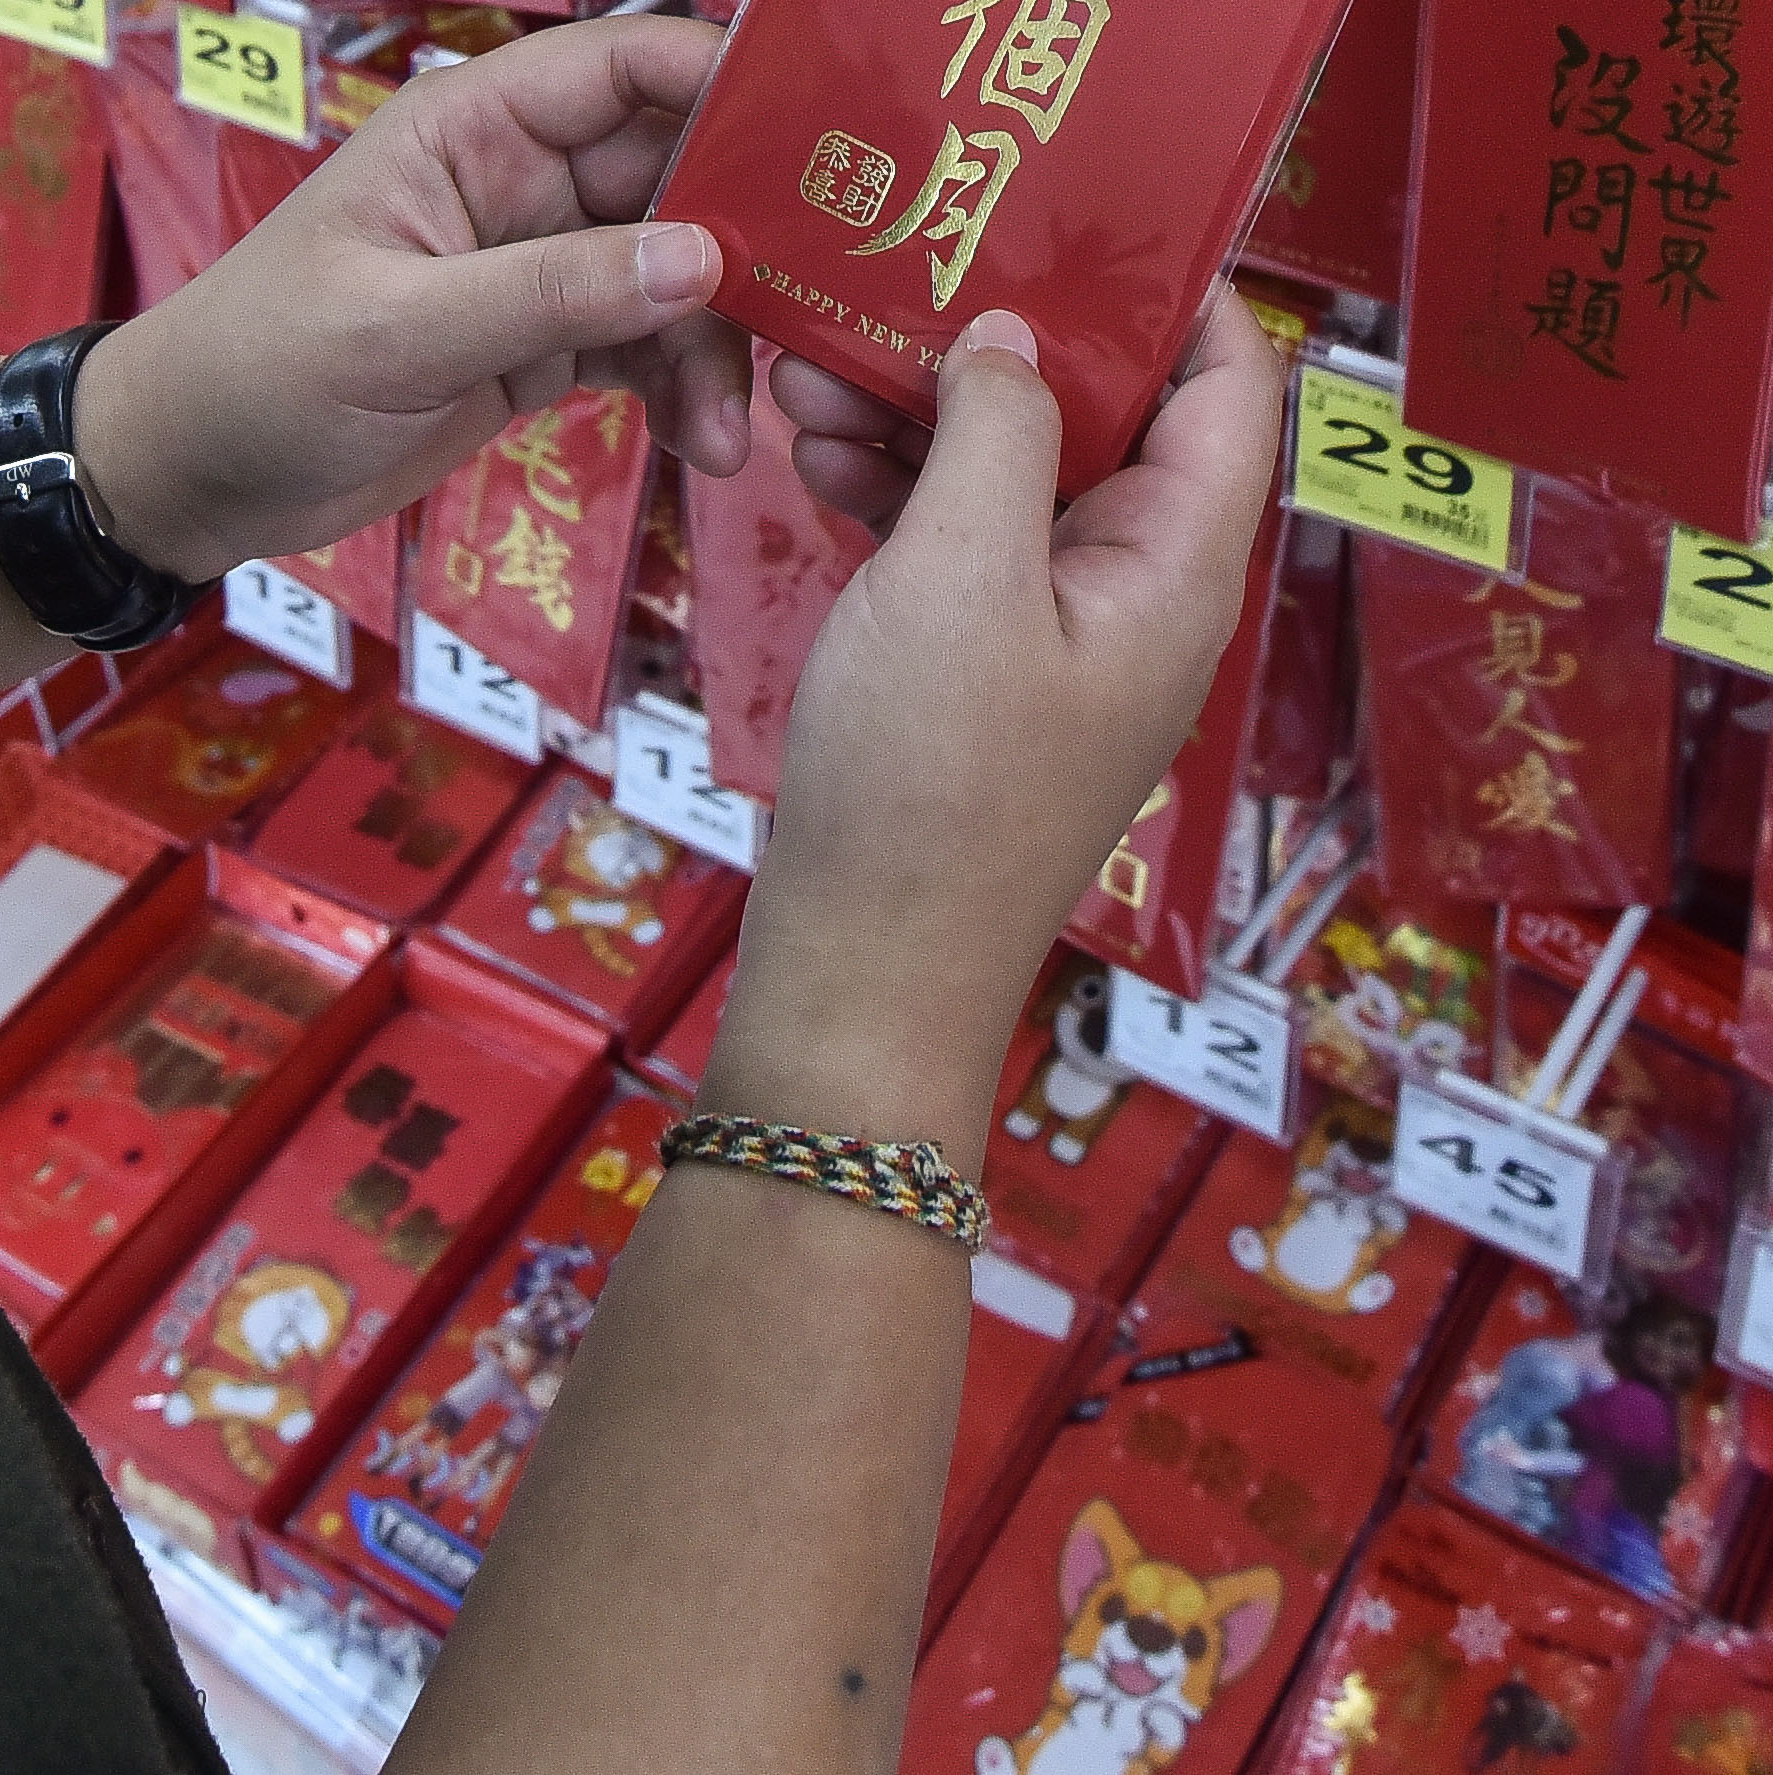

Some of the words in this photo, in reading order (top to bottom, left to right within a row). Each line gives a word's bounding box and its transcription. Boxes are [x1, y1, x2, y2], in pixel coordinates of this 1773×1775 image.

[194, 27, 279, 85] 29
[800, 129, 897, 228] 恭喜發財
[1526, 24, 1654, 381] 沒問題
[771, 269, 852, 323] HAPPY
[856, 314, 912, 355] NEW
[1320, 418, 1475, 496] 29
[249, 569, 317, 619] 12
[437, 641, 519, 705] 12
[1148, 994, 1263, 1073] 12
[1420, 1133, 1559, 1211] 45
